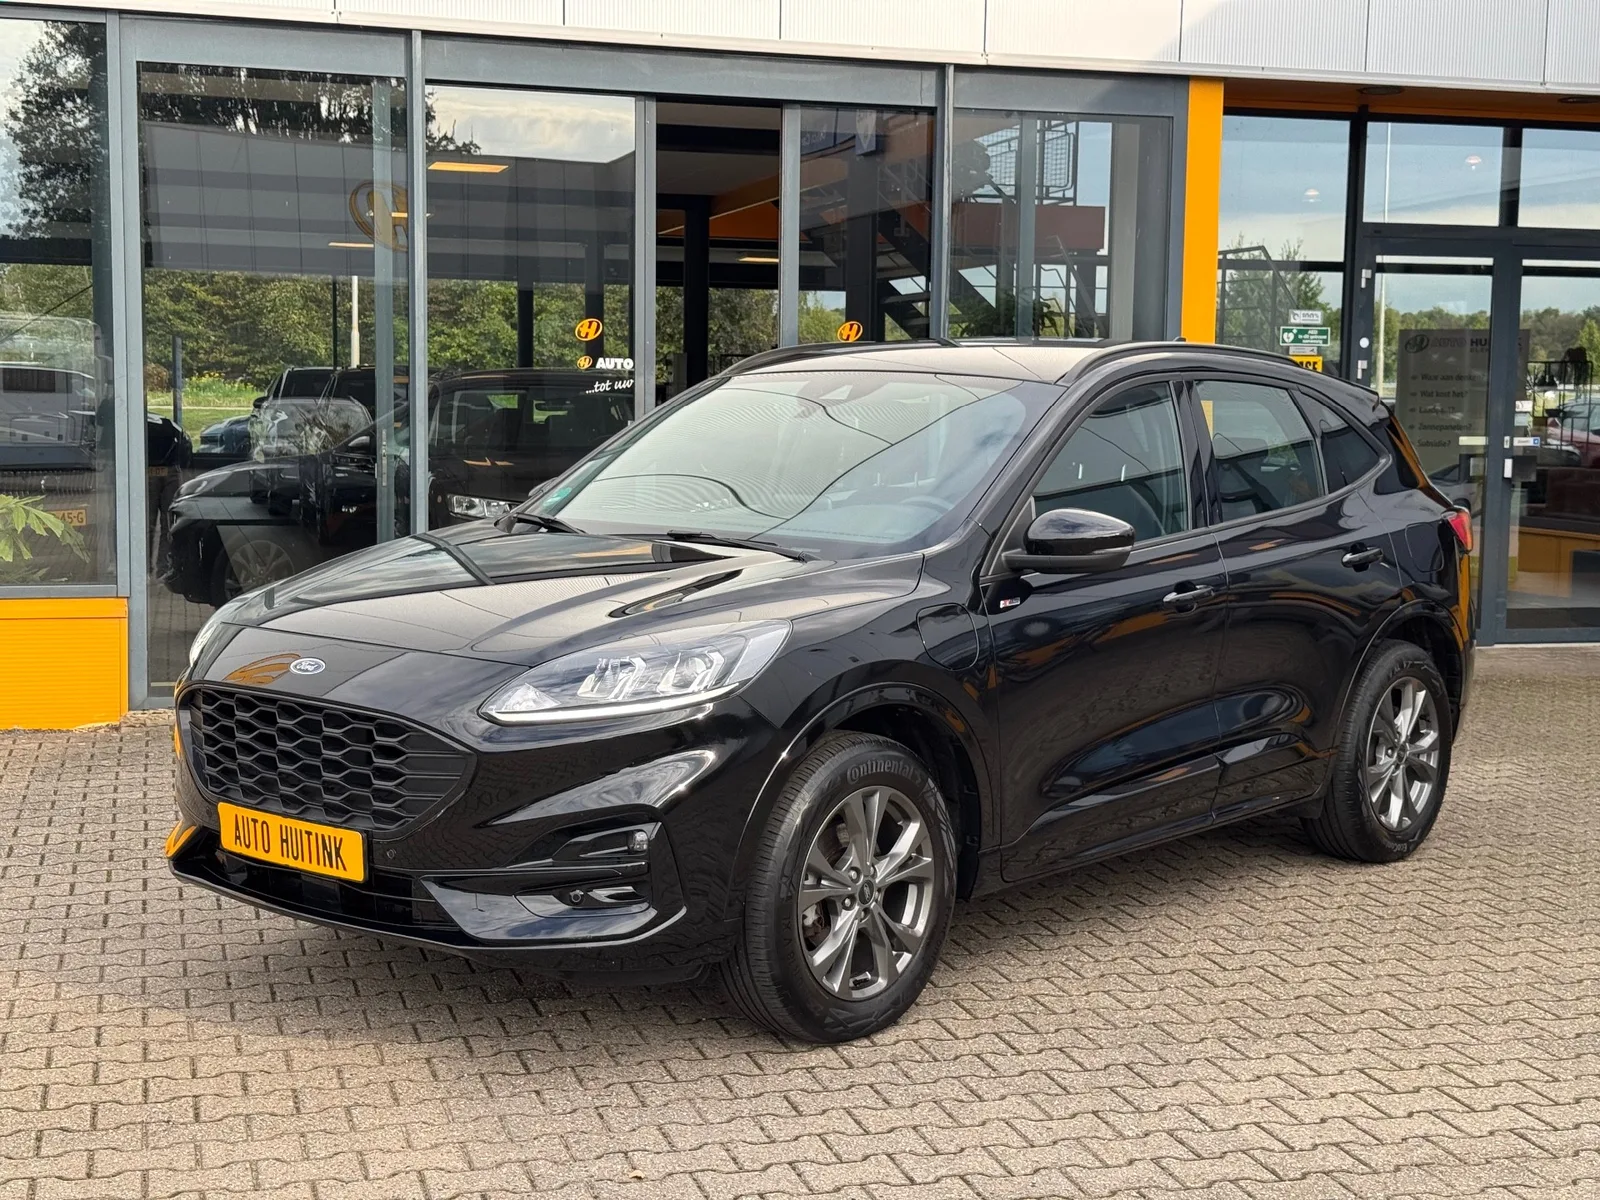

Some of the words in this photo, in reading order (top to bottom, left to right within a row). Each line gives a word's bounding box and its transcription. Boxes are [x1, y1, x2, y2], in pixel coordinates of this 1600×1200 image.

[596, 357, 634, 370] AUTO
[614, 379, 634, 390] uw
[846, 758, 914, 785] Continental
[235, 813, 271, 854] AUTO
[280, 824, 347, 872] HUITINK
